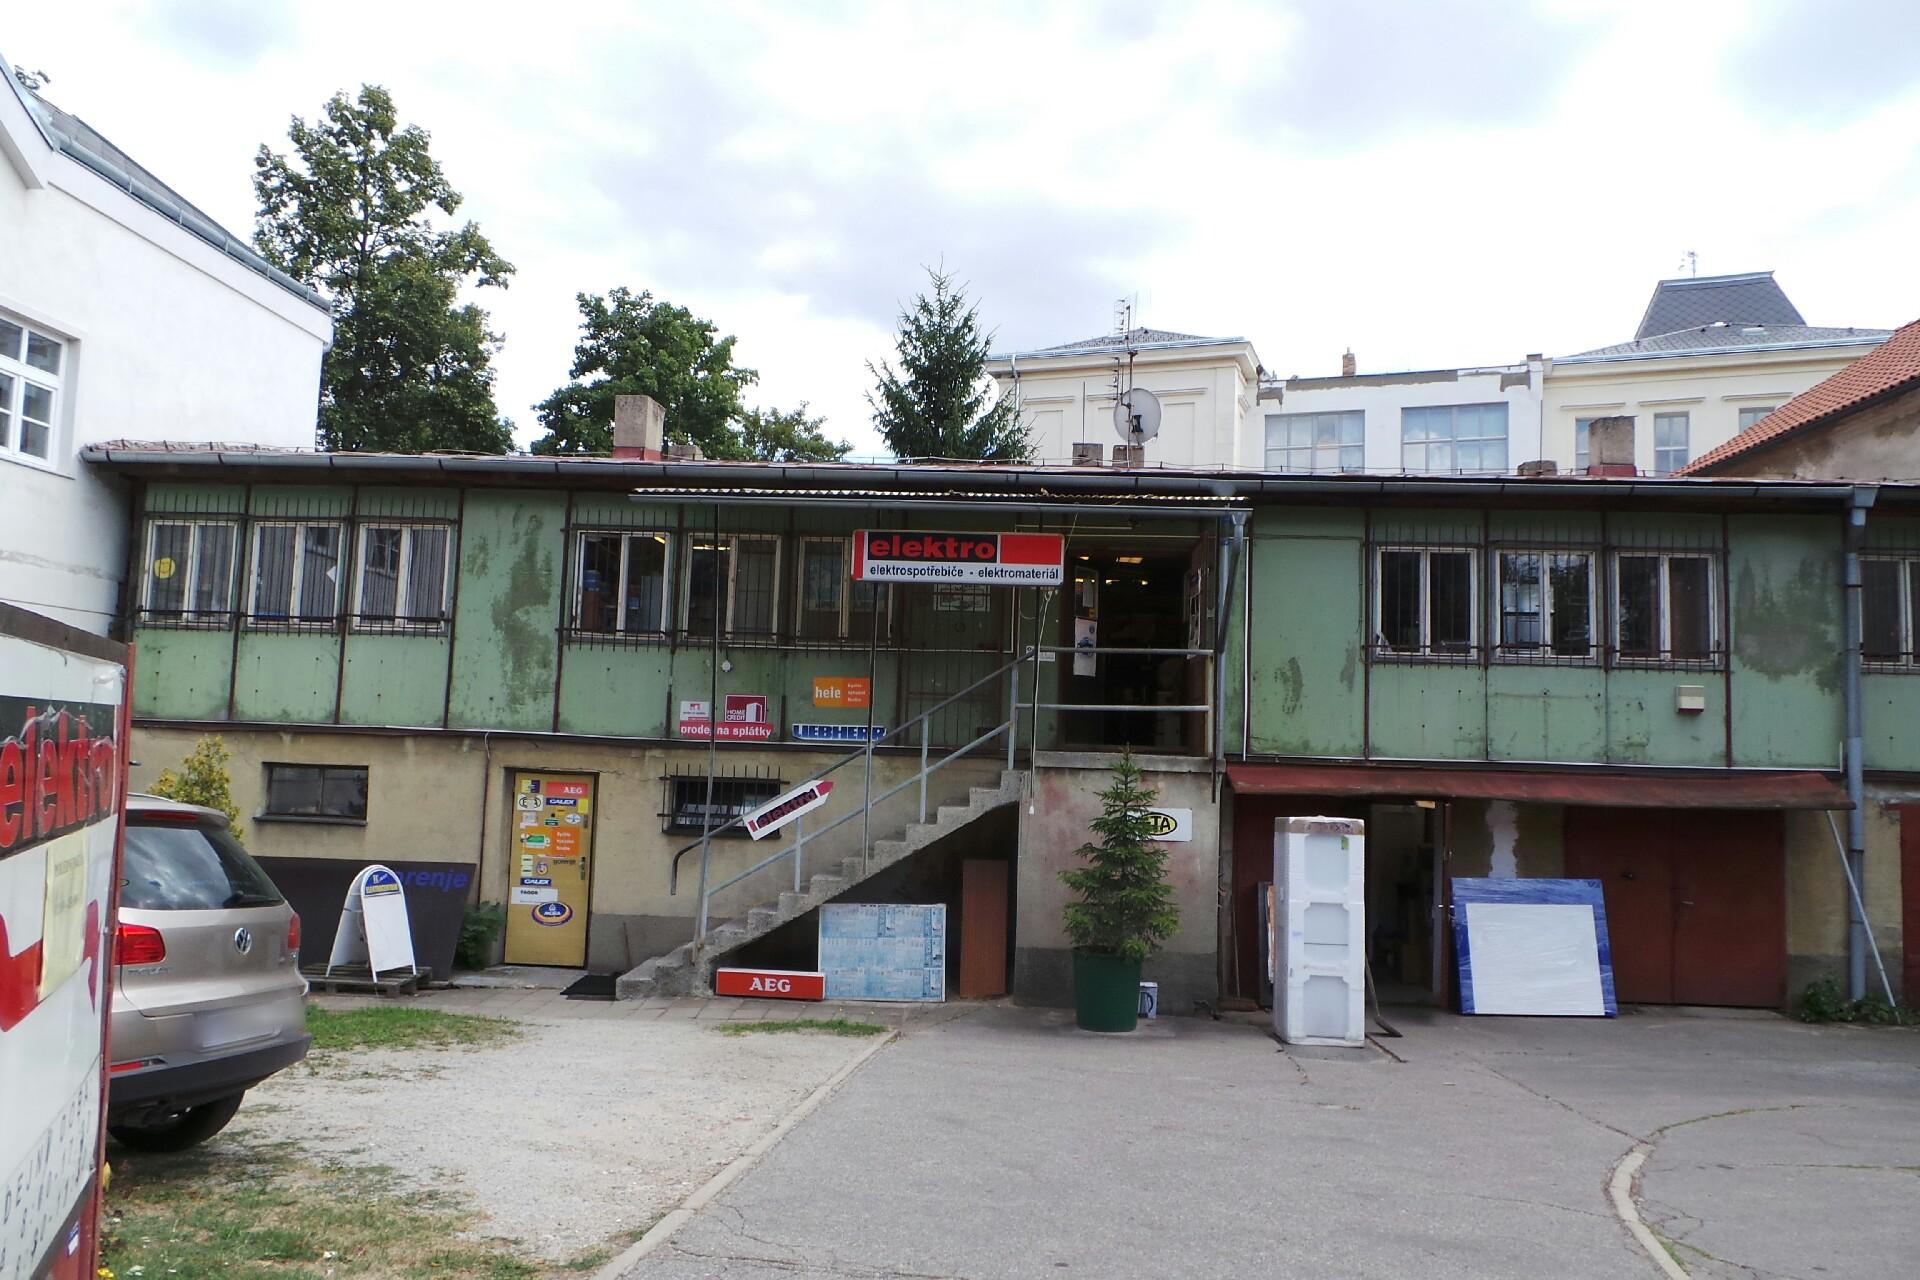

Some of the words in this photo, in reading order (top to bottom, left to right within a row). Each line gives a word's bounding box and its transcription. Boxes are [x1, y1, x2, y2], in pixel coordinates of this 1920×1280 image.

[870, 535, 996, 559] elektro
[870, 565, 964, 578] elektrospotřebiče
[978, 566, 1059, 579] elektromateriál
[815, 686, 841, 699] hele
[717, 727, 730, 735] na
[732, 726, 772, 738] splátky
[793, 724, 887, 741] LIEBHERR
[0, 705, 114, 848] elektro
[563, 786, 583, 794] AEG
[756, 787, 819, 830] elektro
[749, 977, 791, 993] AEG
